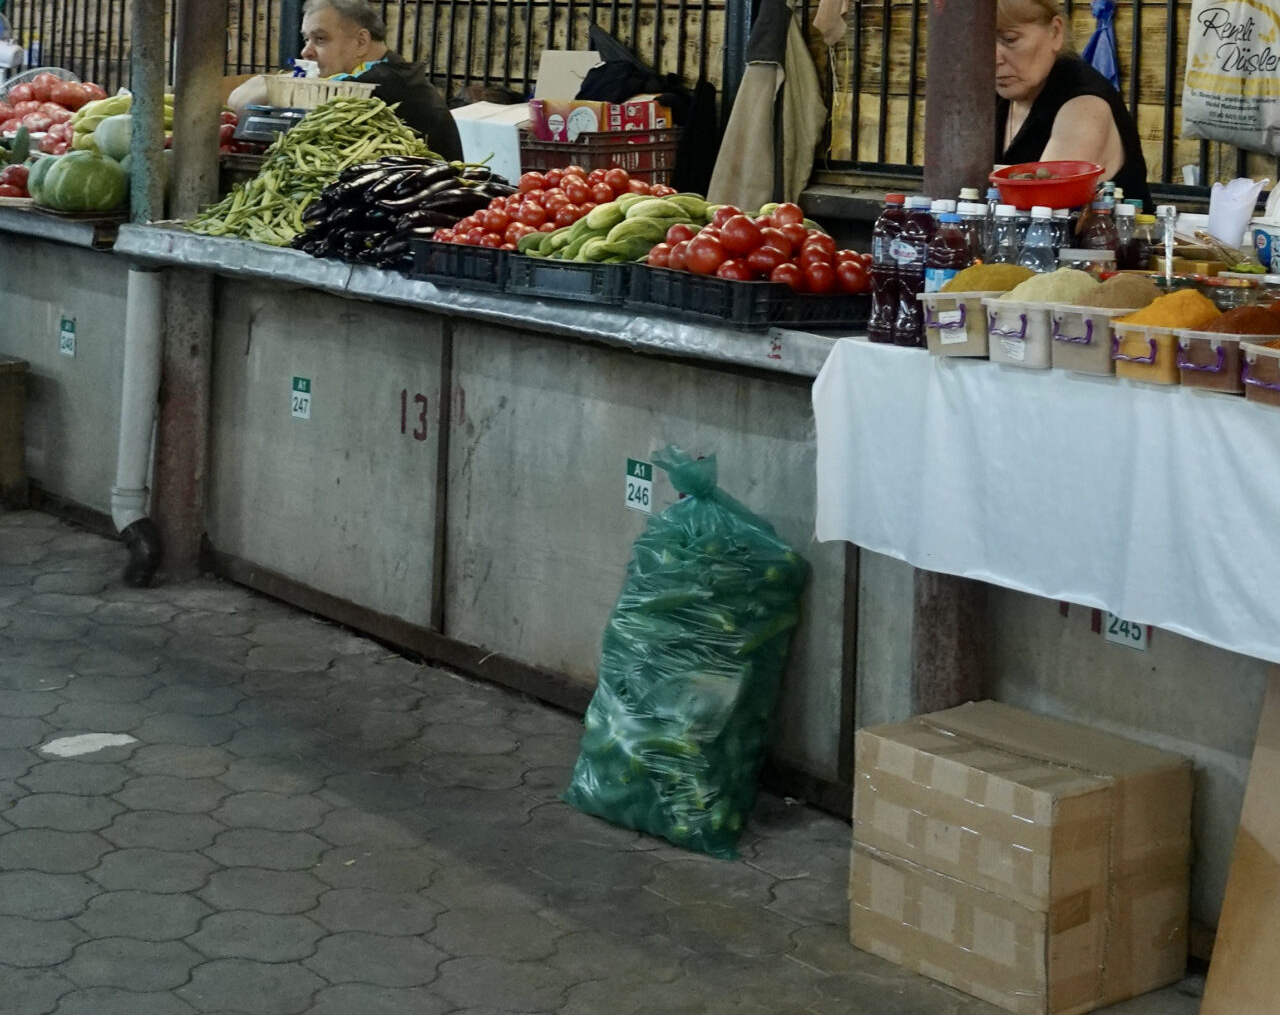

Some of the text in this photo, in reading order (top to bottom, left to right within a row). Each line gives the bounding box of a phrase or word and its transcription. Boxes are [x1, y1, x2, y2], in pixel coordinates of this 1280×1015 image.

[293, 396, 309, 414] 247
[633, 463, 646, 477] A1
[627, 483, 649, 506] 246
[1108, 613, 1141, 640] 245
